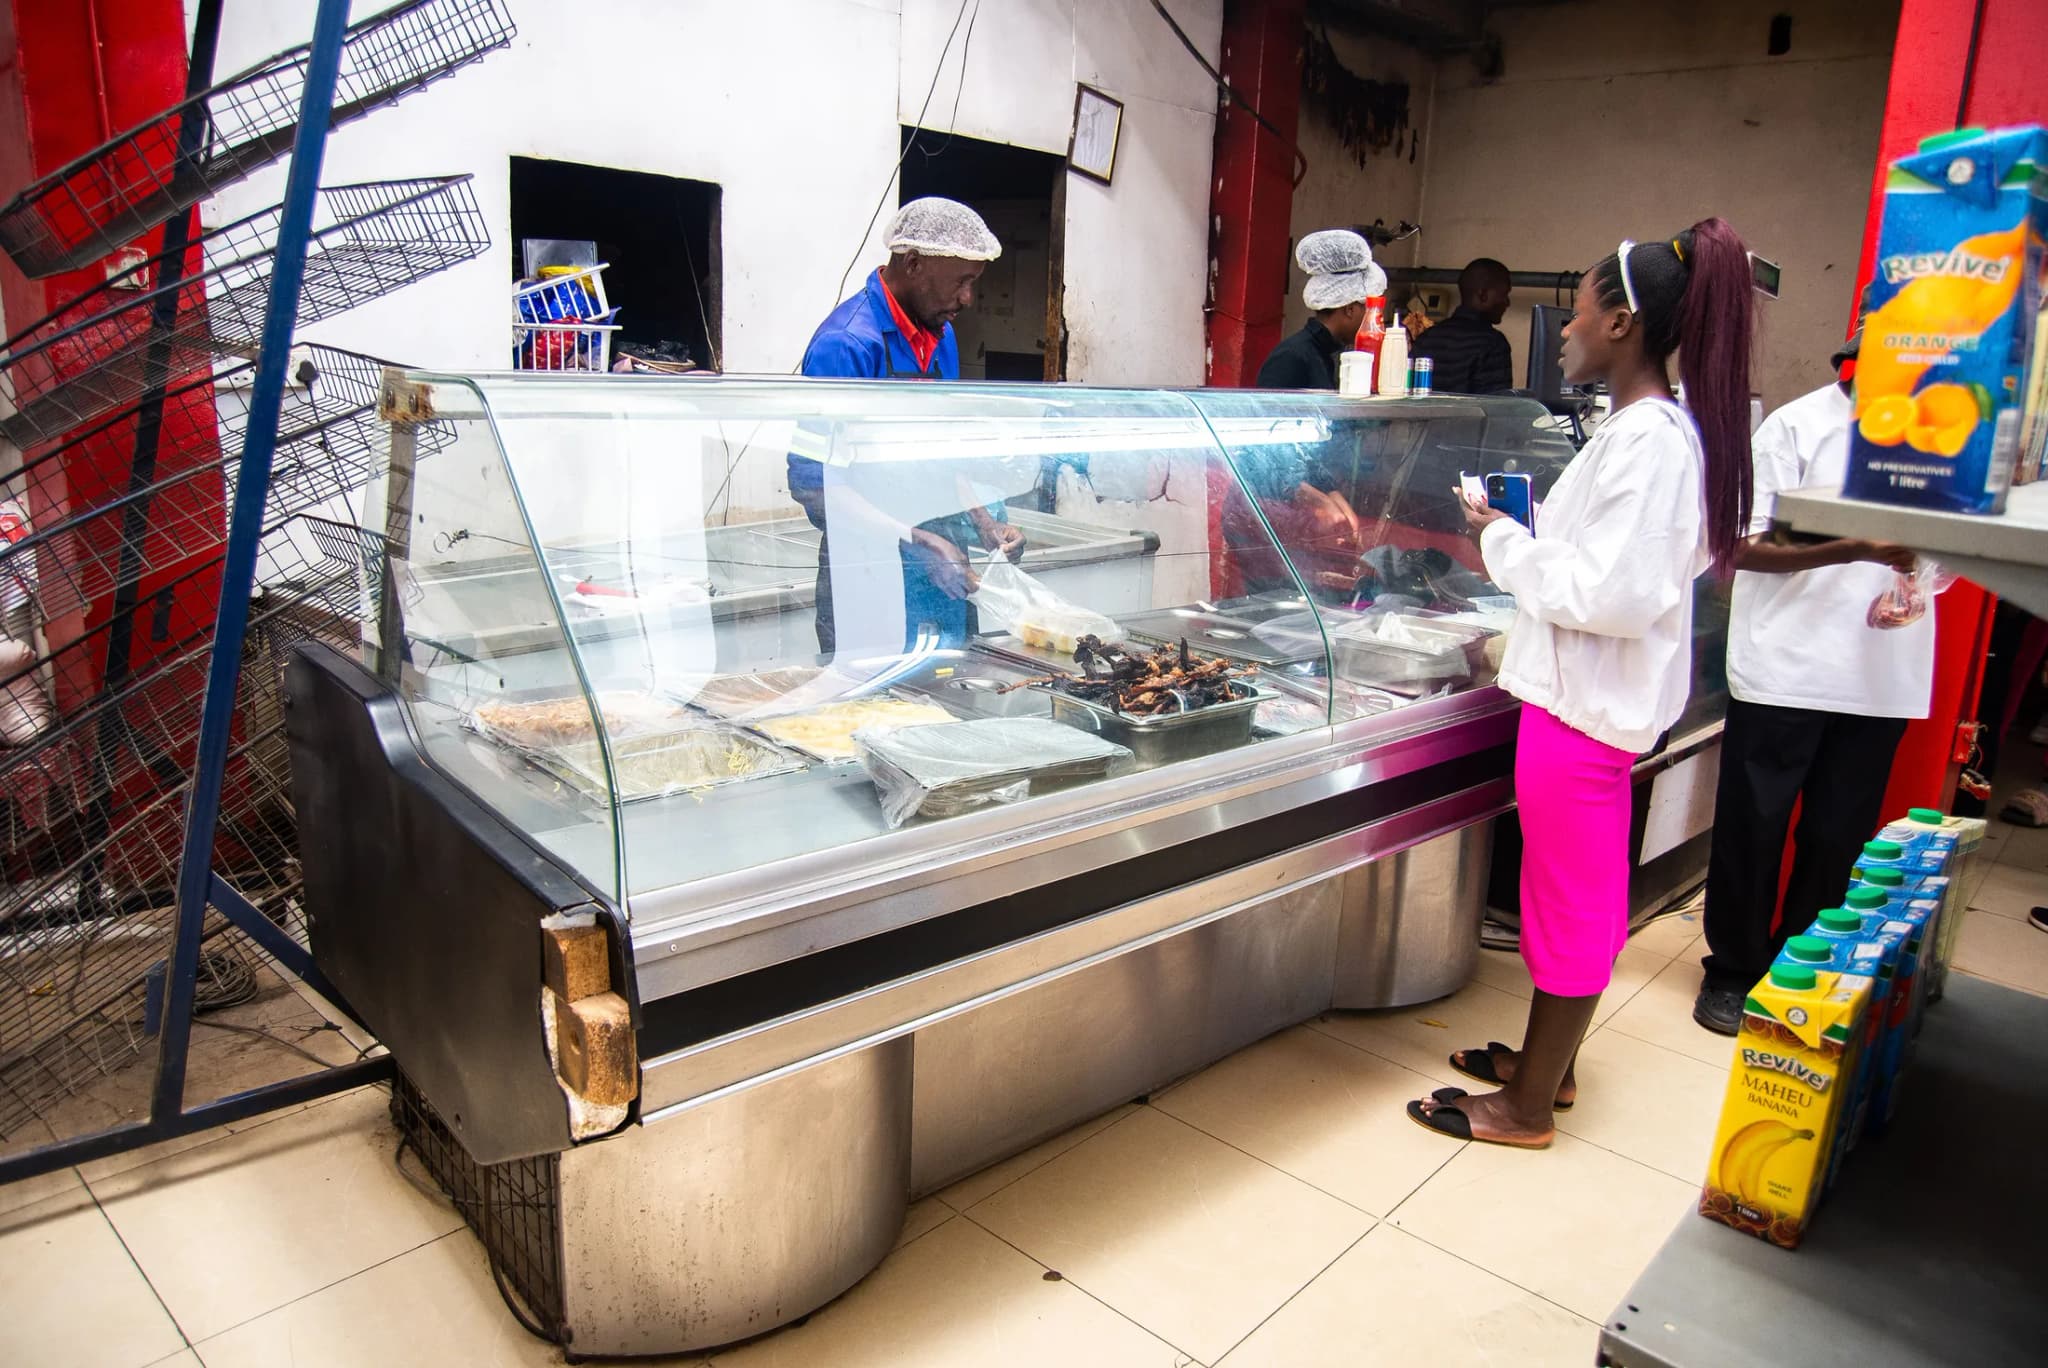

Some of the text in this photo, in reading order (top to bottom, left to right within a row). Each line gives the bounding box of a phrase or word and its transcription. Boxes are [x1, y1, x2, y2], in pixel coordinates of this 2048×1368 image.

[1881, 251, 2006, 284] Revive
[1883, 334, 1979, 351] ORANGE
[1883, 463, 1954, 477] PRESERVATIVES
[1899, 475, 1927, 489] litre
[1742, 1048, 1830, 1091] Revive
[1742, 1073, 1813, 1108] MAHEU
[1747, 1092, 1799, 1119] BANANA
